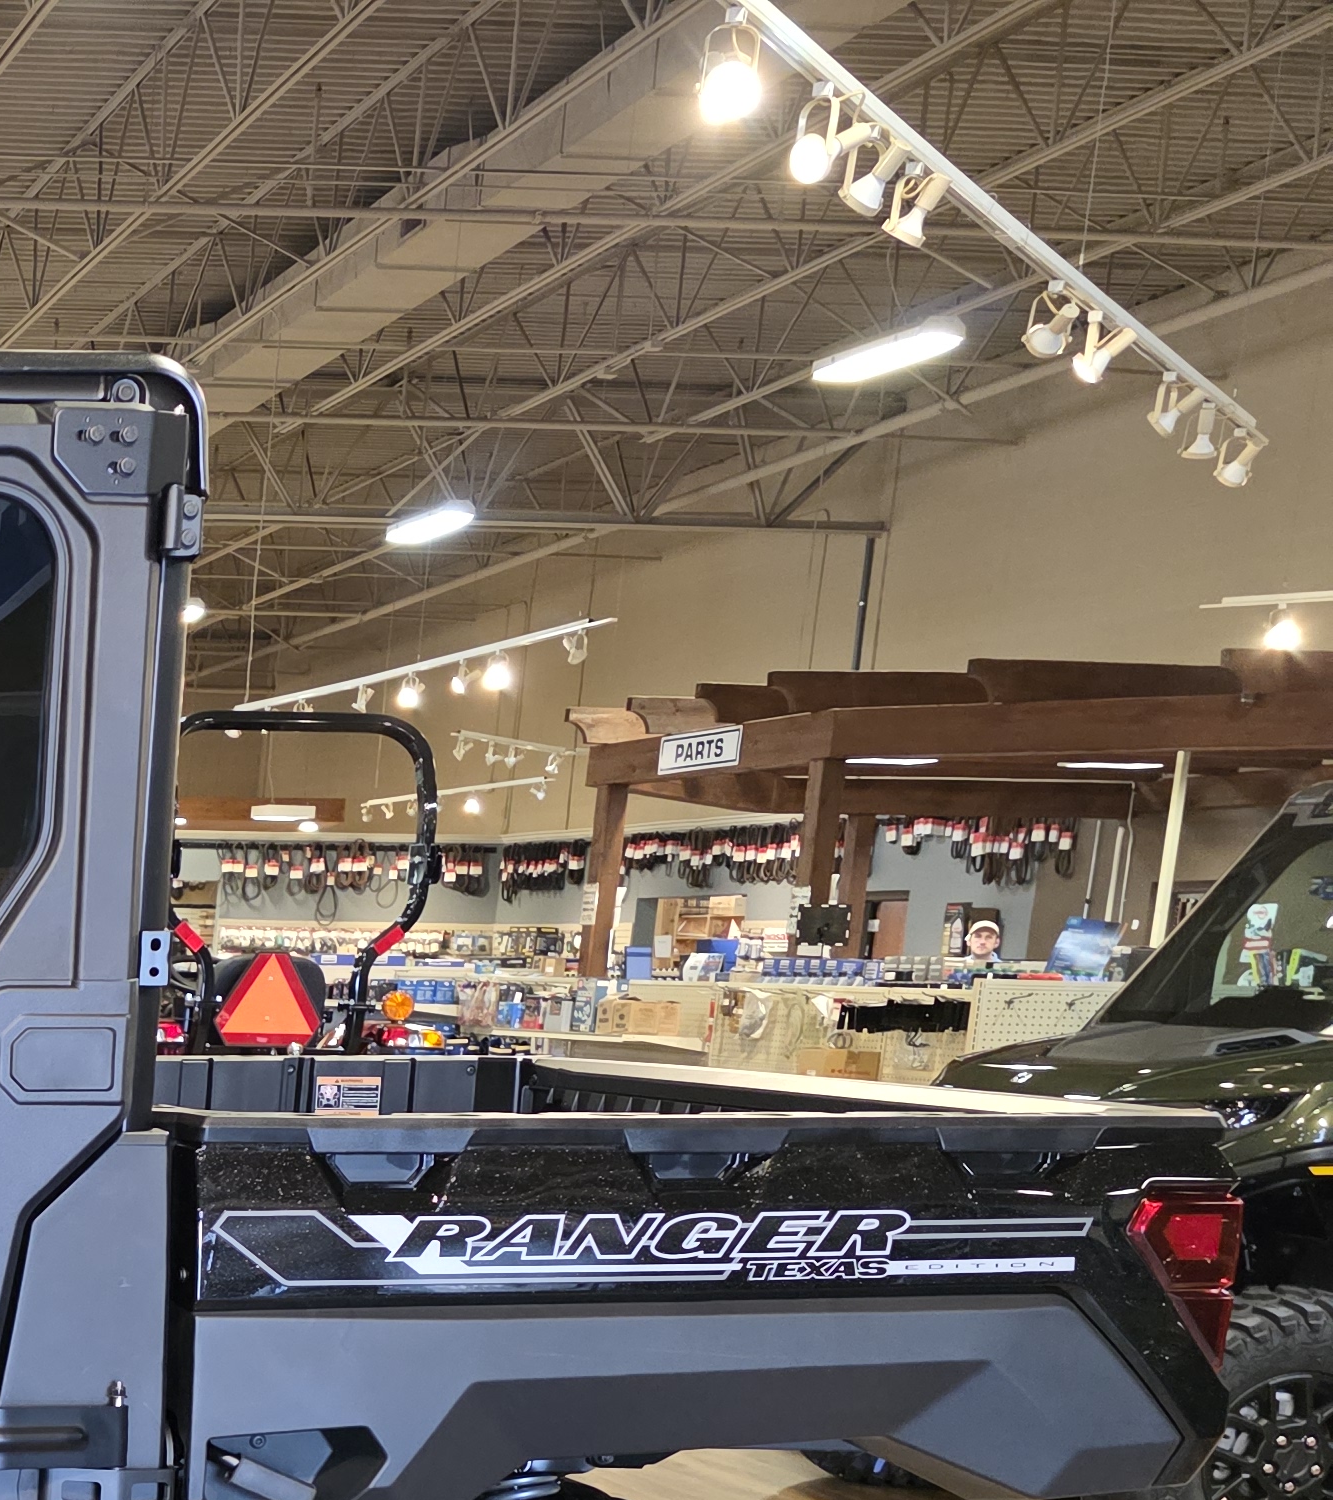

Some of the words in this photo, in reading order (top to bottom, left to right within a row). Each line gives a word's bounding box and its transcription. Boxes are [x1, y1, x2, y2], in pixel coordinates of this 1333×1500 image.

[674, 738, 724, 763] PARTS
[384, 1209, 912, 1263] RANGER
[746, 1258, 890, 1282] TEXAS
[904, 1260, 1056, 1272] EDITION
